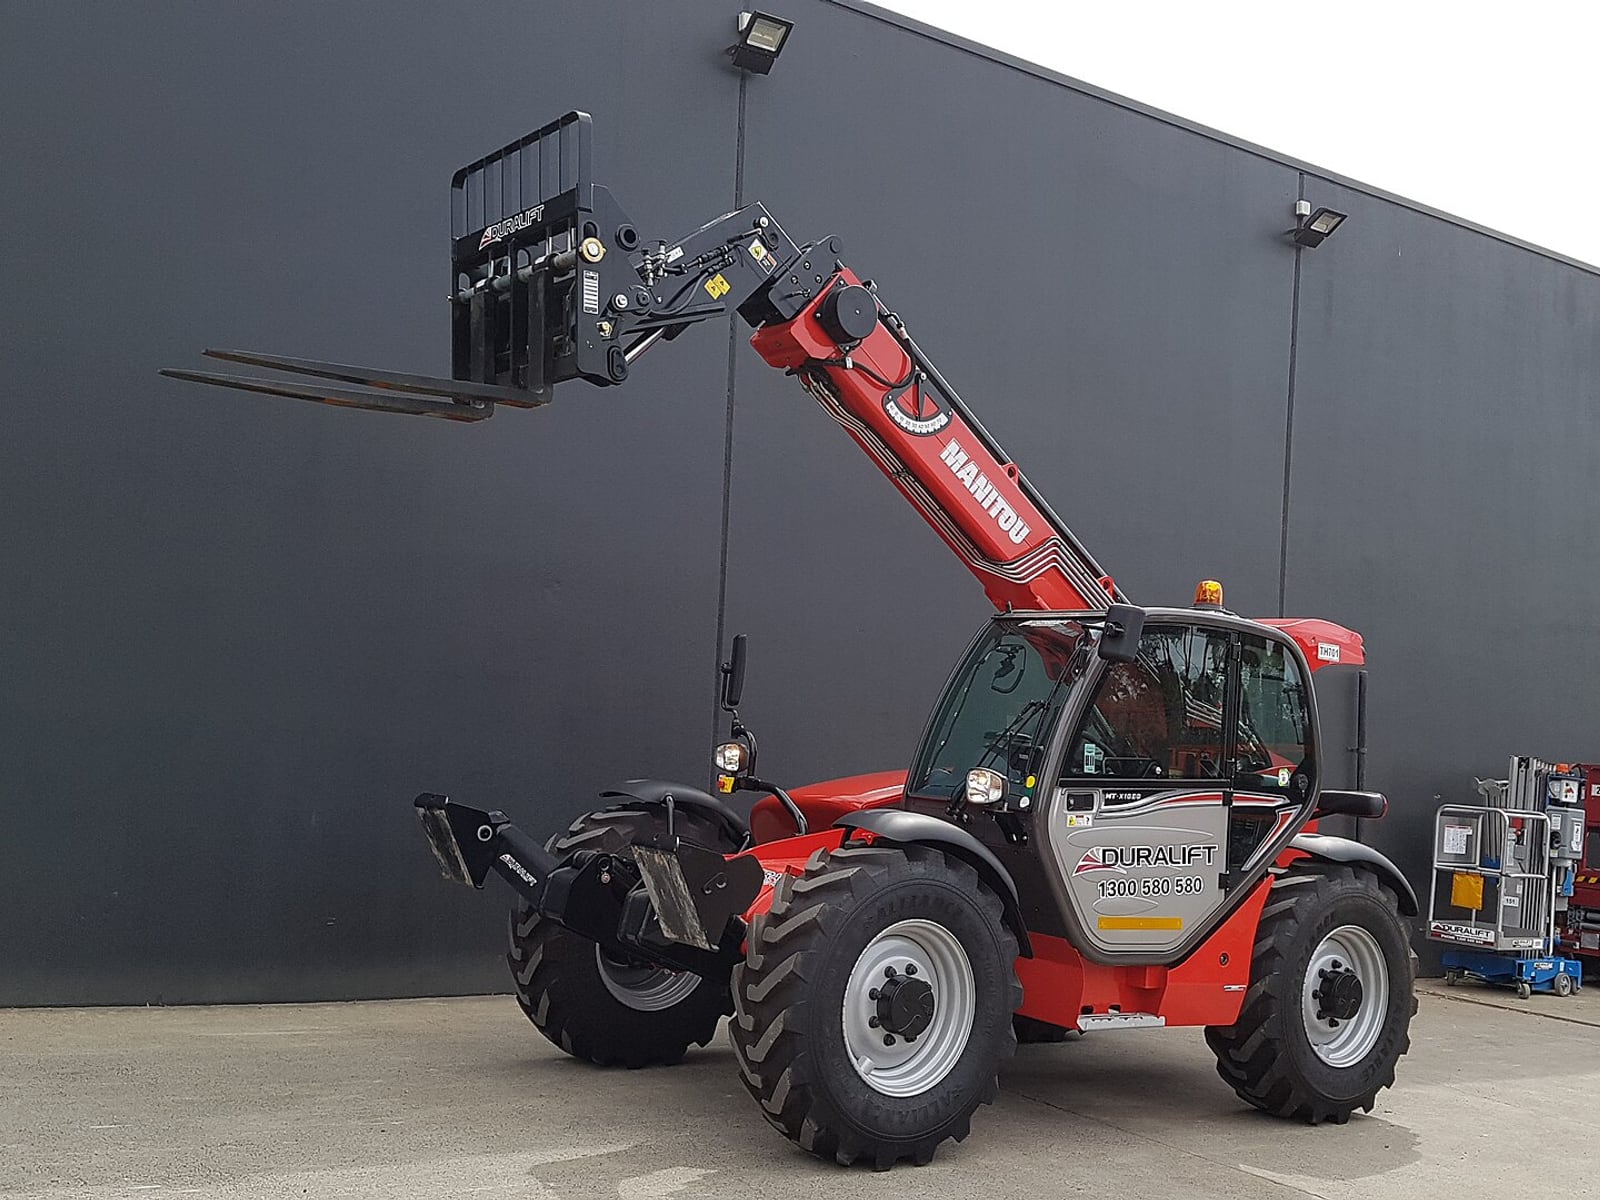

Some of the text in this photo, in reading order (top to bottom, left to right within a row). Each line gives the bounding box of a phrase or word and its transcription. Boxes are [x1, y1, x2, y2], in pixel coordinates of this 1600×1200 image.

[490, 204, 545, 238] DURALIFT
[939, 438, 1032, 545] MANITOU
[1101, 845, 1218, 867] DURALIFT
[1098, 876, 1203, 897] 1300 580 580
[1443, 924, 1491, 938] DURALIFT
